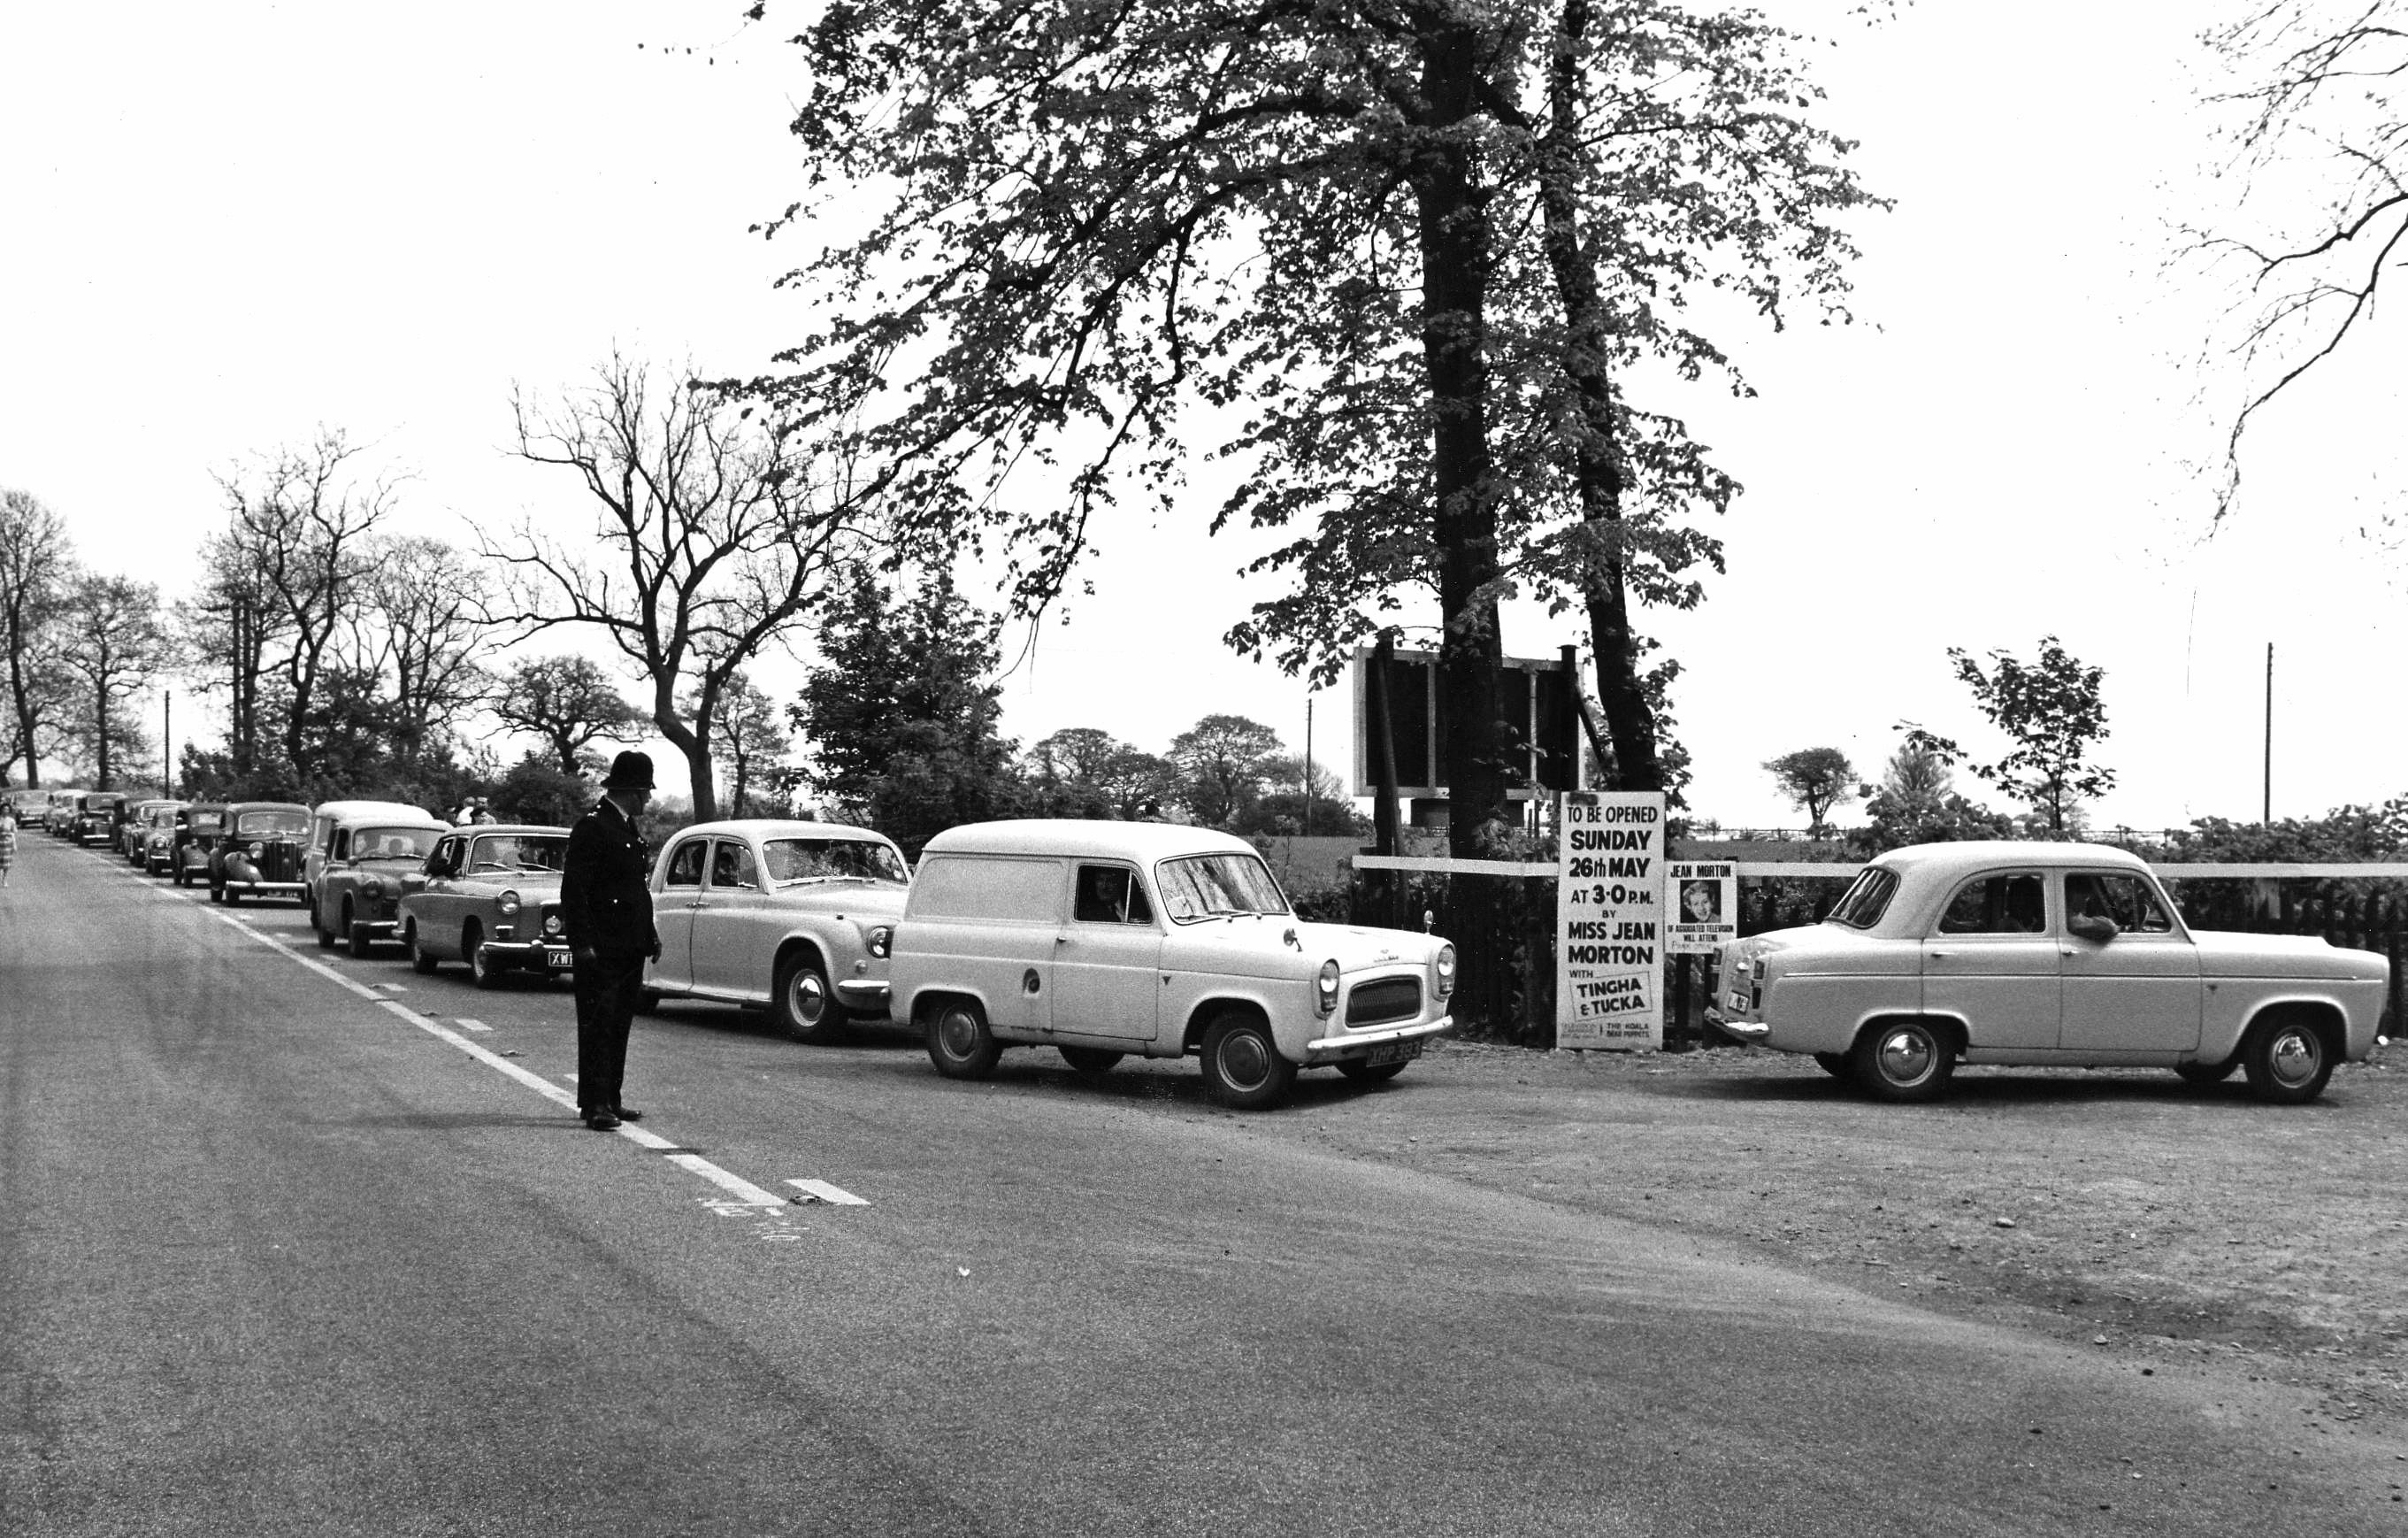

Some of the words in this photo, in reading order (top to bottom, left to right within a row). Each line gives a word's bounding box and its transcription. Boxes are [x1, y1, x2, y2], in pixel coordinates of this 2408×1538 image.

[1568, 806, 1583, 823] TO
[1587, 806, 1601, 823] BE
[1606, 806, 1658, 823] OPENED
[1570, 830, 1652, 850] SUNDAY
[1569, 857, 1606, 878] 26th
[1608, 857, 1651, 878] MAY
[1670, 865, 1691, 878] JEAN
[1697, 865, 1731, 878] MORTON
[1571, 889, 1589, 904] AT
[1629, 890, 1653, 904] P.M.
[1602, 910, 1616, 919] BY
[1568, 921, 1607, 940] MISS
[1612, 922, 1655, 940] JEAN
[1568, 945, 1653, 965] MORTON
[1576, 978, 1642, 998] TINGHA
[1580, 1004, 1590, 1016] &
[1591, 995, 1645, 1014] TUCKA
